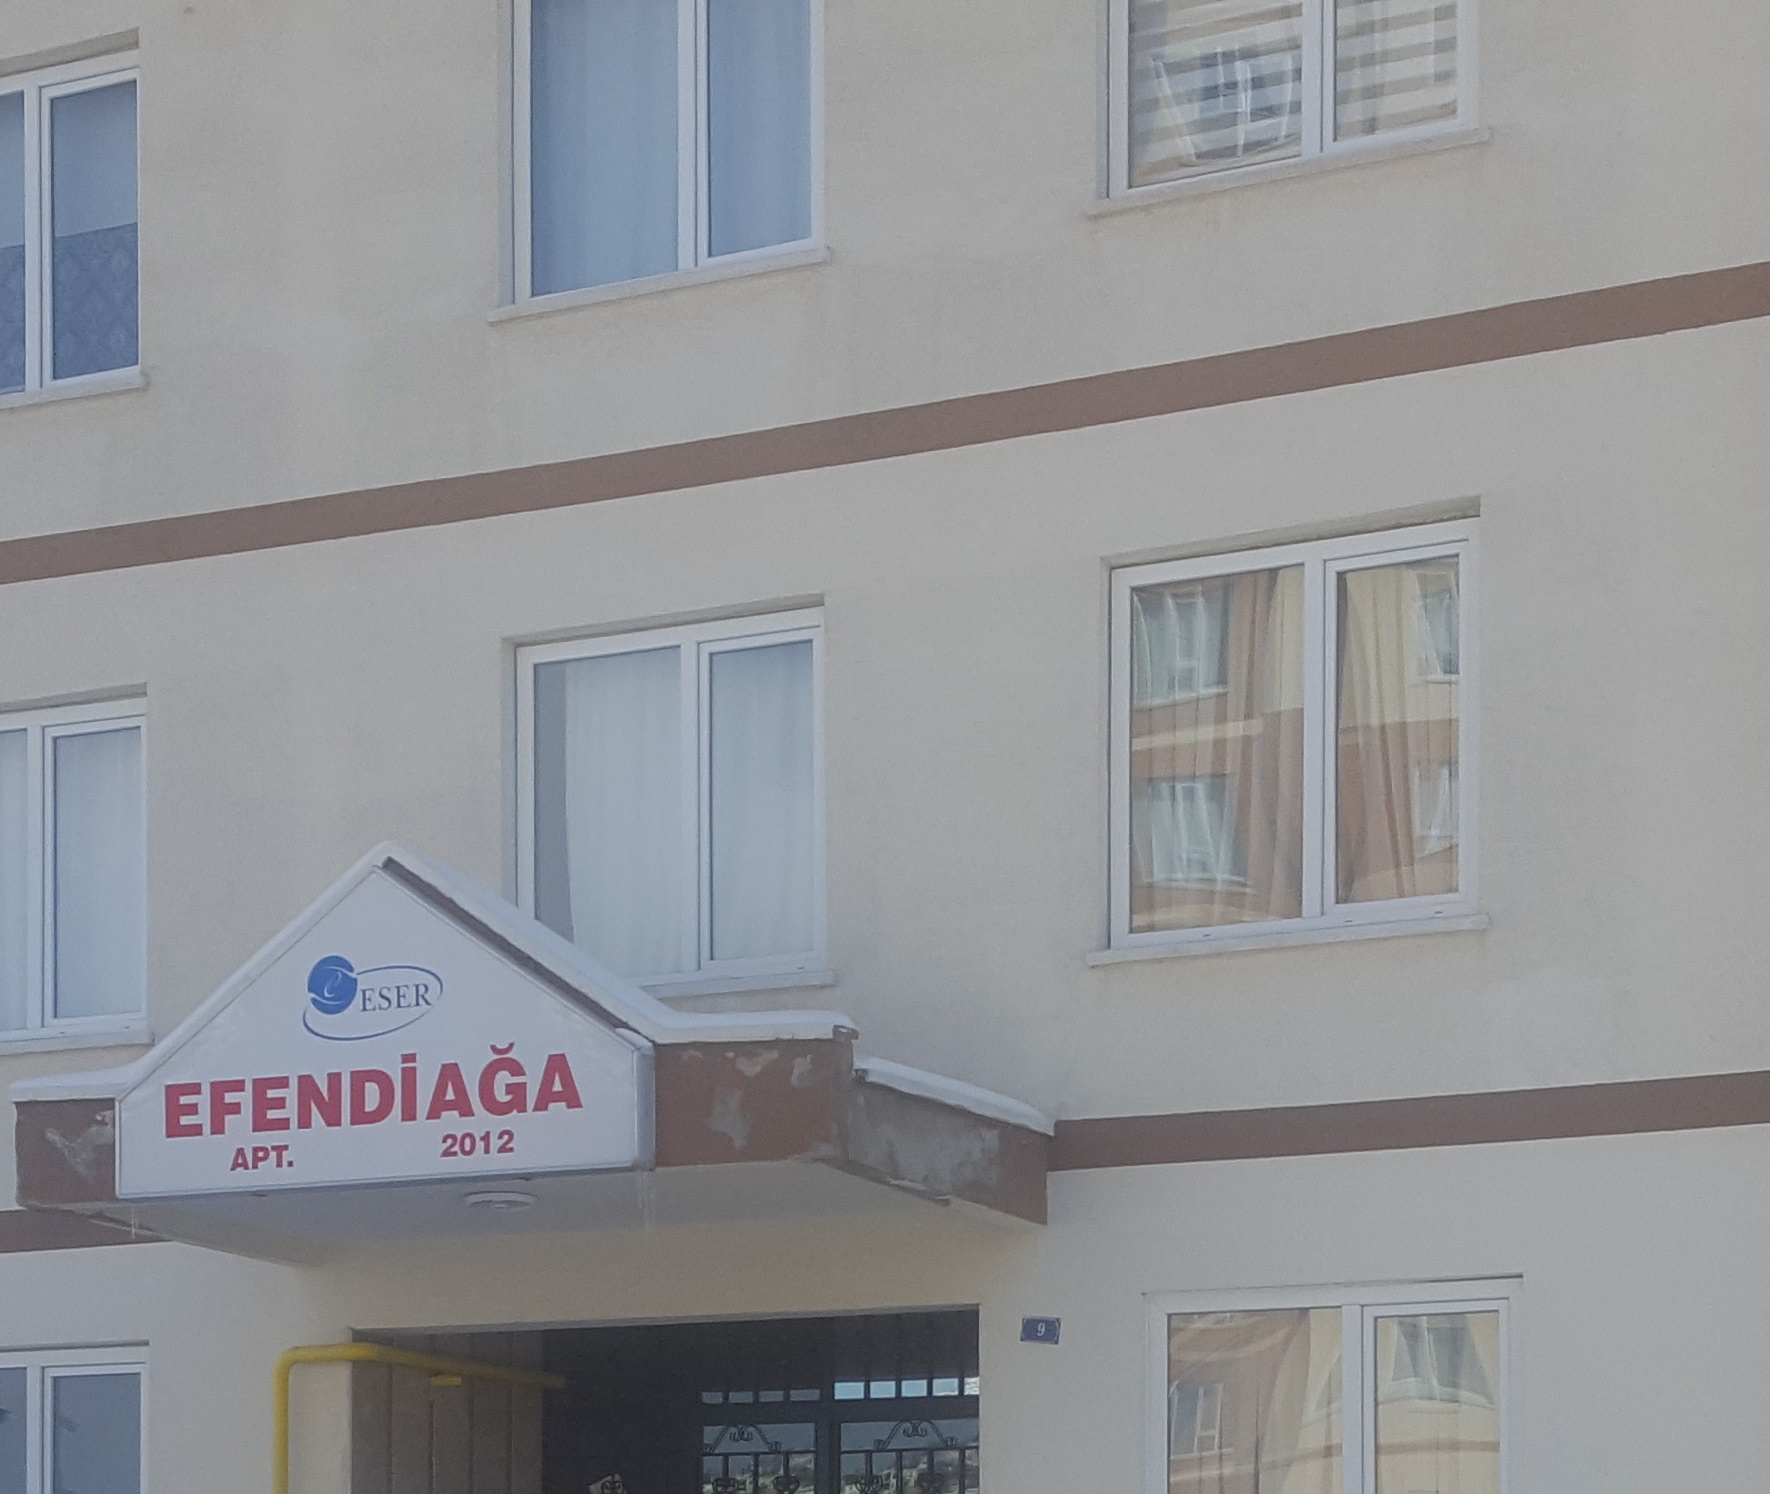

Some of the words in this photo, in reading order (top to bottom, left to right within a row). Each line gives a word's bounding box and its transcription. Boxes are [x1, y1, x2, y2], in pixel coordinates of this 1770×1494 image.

[360, 983, 433, 1012] ESER
[164, 1042, 584, 1139] EFENDİAĞA
[230, 1144, 294, 1171] APT.
[440, 1129, 515, 1158] 2012
[1036, 1322, 1046, 1337] 9
